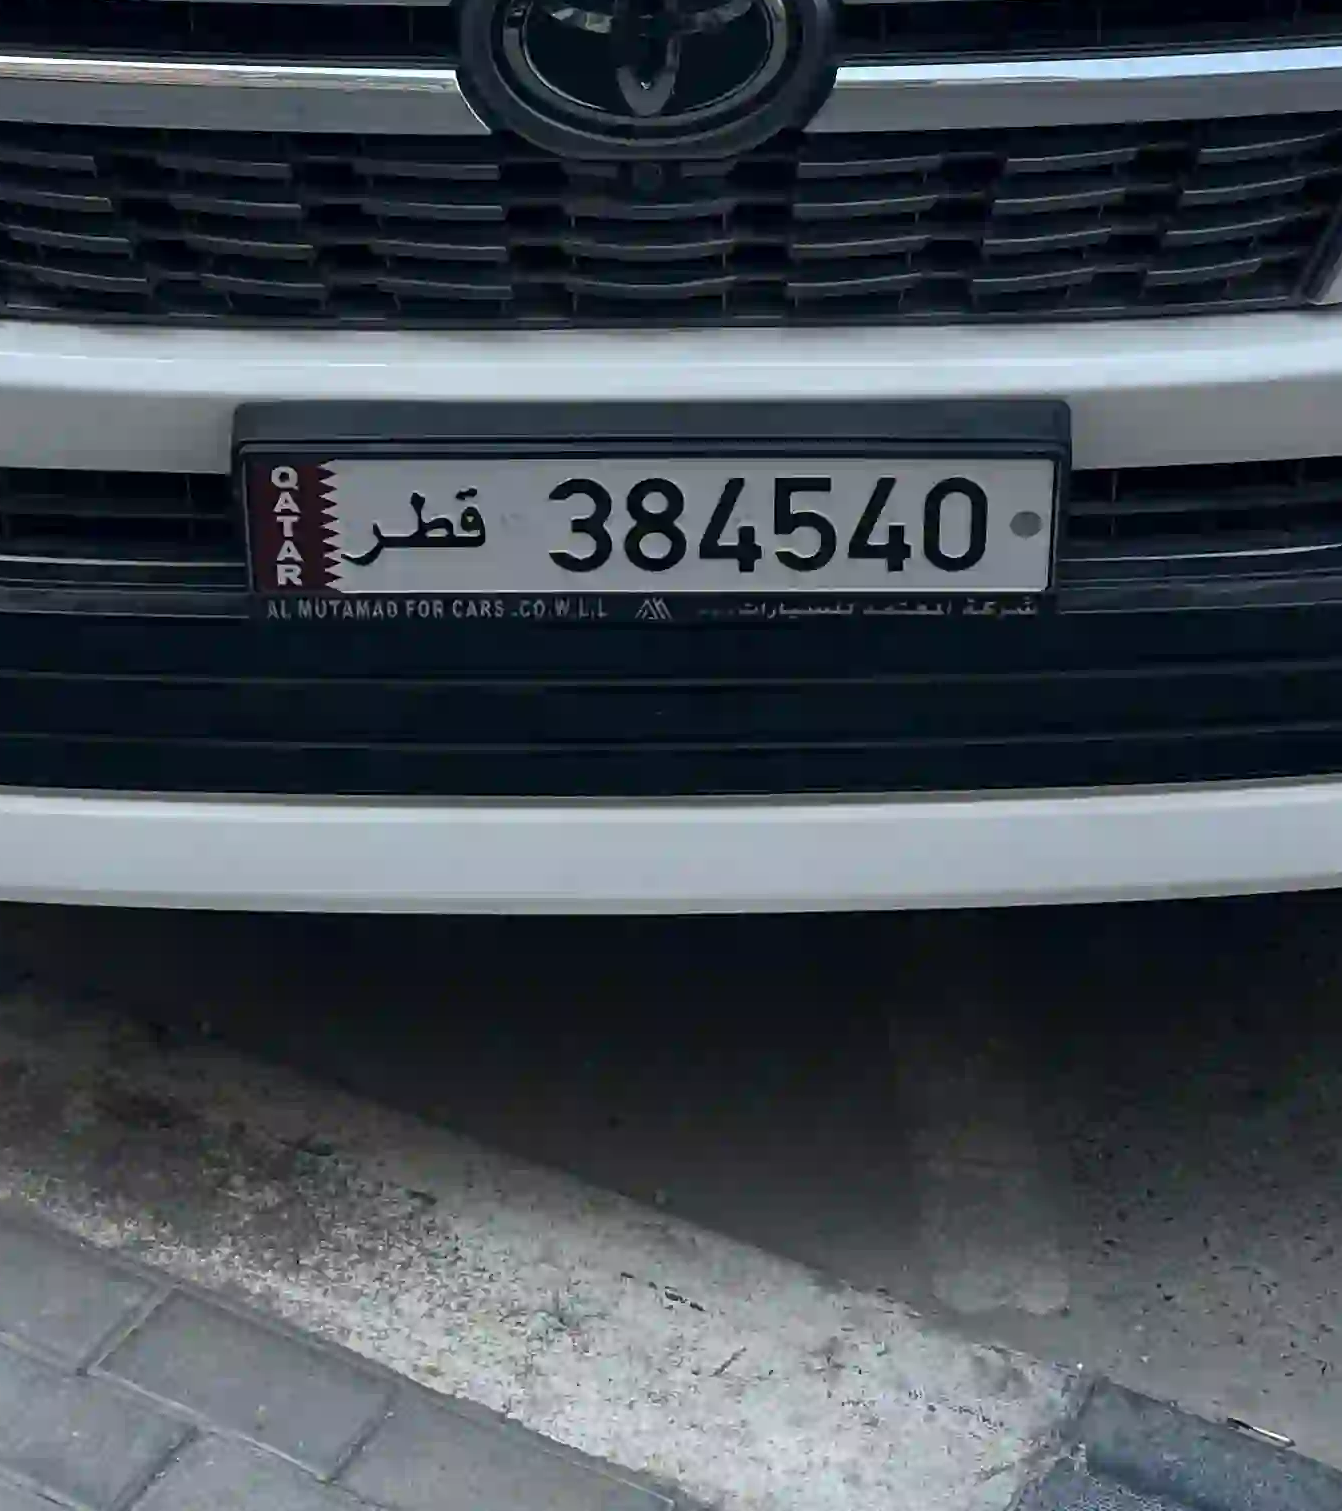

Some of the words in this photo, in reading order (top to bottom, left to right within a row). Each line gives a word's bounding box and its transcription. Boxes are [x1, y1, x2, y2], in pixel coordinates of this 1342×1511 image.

[270, 465, 305, 587] QATAR
[341, 486, 486, 567] قطر
[547, 476, 989, 573] 384540
[267, 599, 292, 619] AL
[297, 598, 399, 619] MUTAMAD
[405, 598, 445, 618] FOR
[451, 598, 506, 618] CARS
